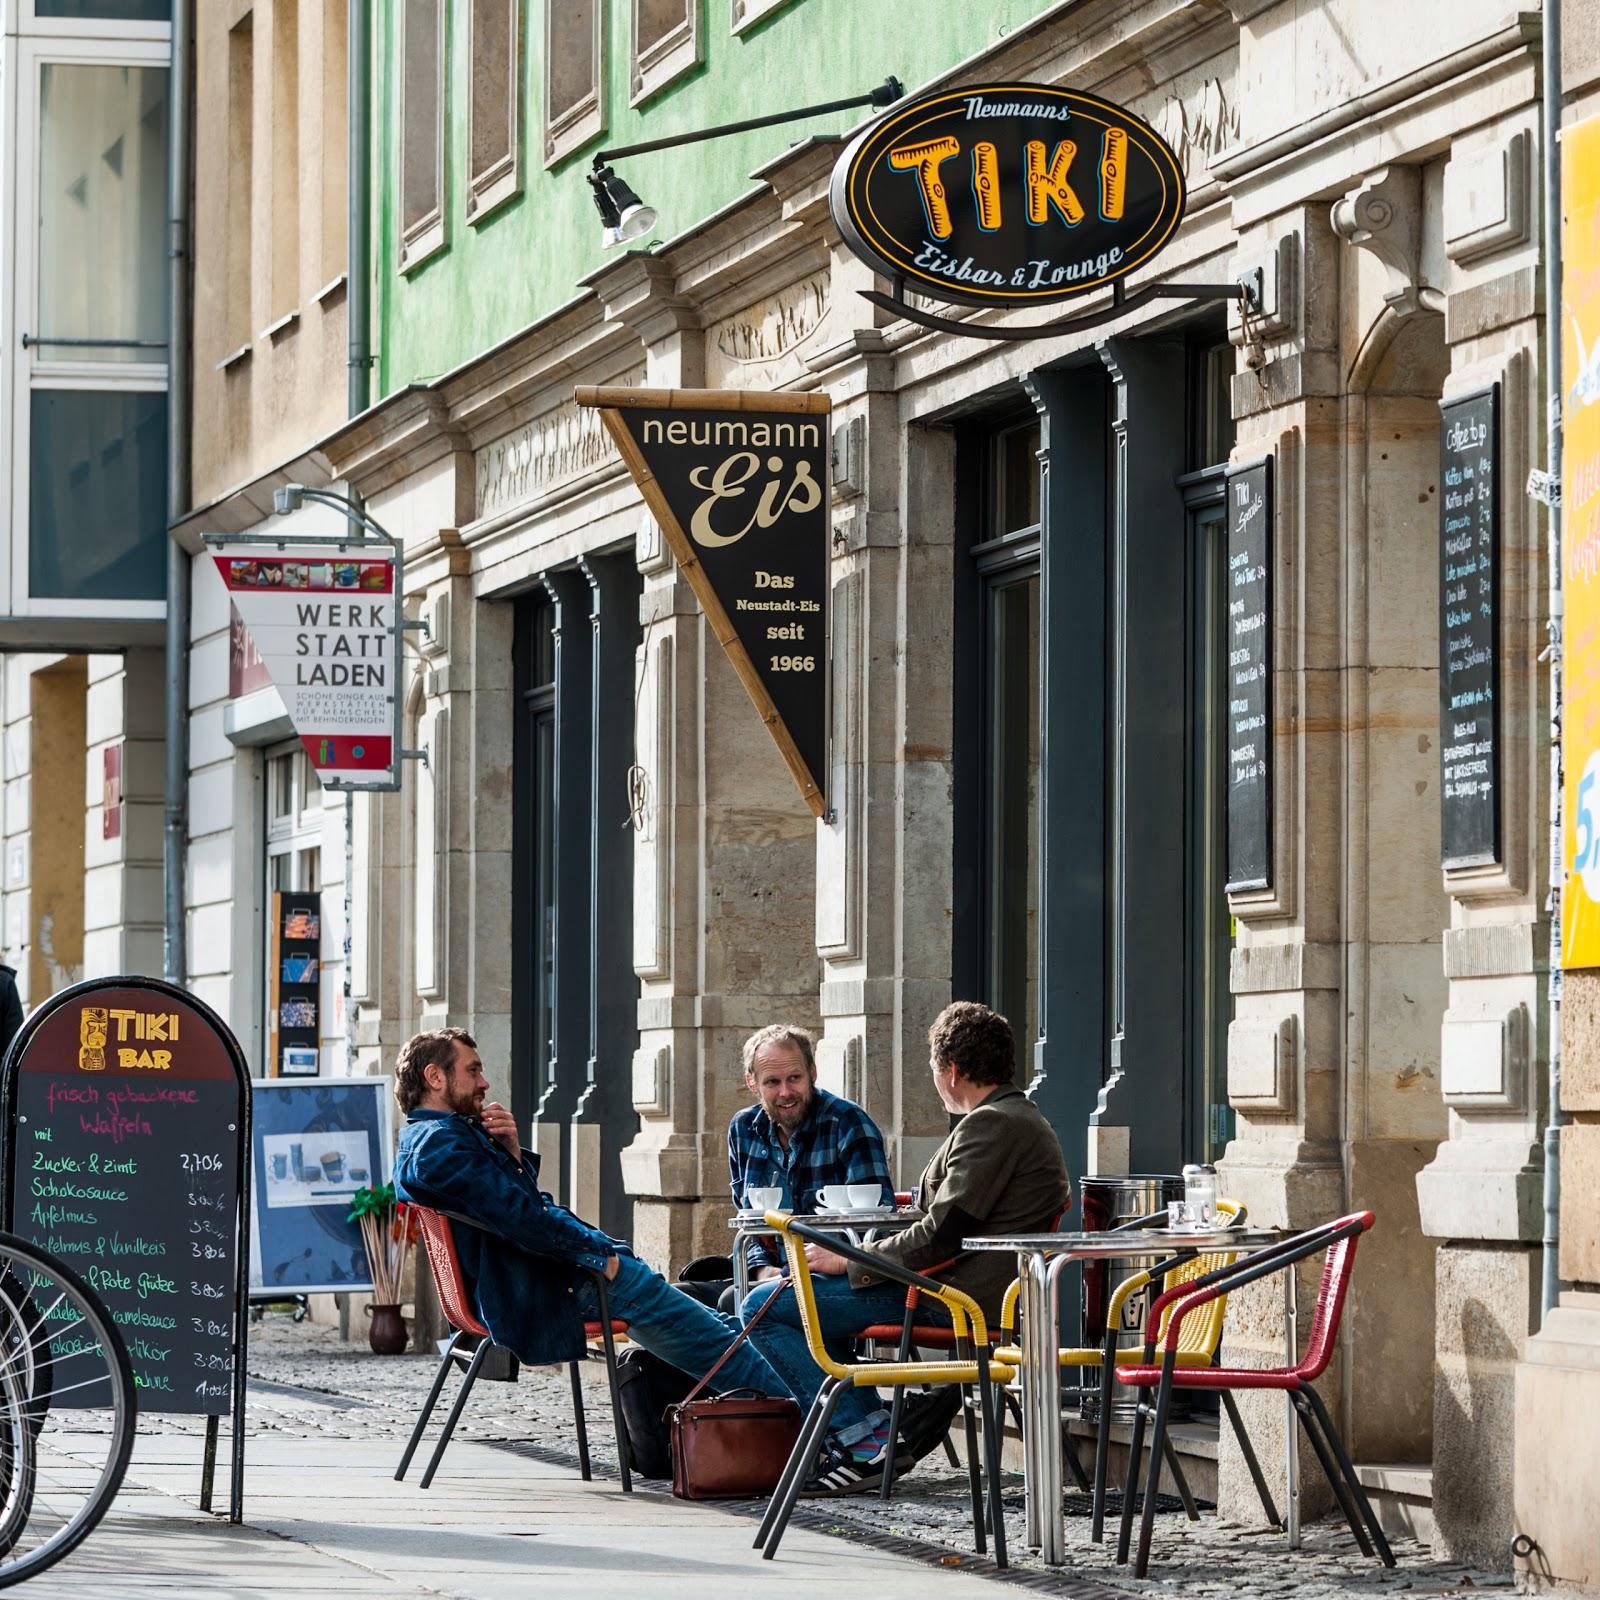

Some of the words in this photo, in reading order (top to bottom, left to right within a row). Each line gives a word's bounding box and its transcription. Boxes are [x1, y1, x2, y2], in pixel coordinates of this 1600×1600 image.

[964, 96, 1070, 121] Neumanns
[888, 126, 1128, 243] TIKI
[913, 240, 1007, 287] Eisbar
[1010, 268, 1026, 287] &
[1027, 245, 1124, 290] Lounge
[643, 419, 819, 447] neumann
[689, 452, 822, 548] Eis
[755, 571, 795, 589] Das
[297, 604, 385, 627] WERK
[736, 599, 820, 612] Neustadt-Eis
[767, 623, 805, 640] seit
[296, 633, 386, 657] STATT
[770, 655, 815, 672] 1966
[297, 664, 385, 687] LADEN
[296, 692, 333, 700] SCHÖNE
[337, 693, 364, 701] DINGE
[368, 693, 385, 701] AUS
[296, 708, 315, 716] FÜR
[313, 716, 385, 724] BEHINDERUNGEN
[109, 1008, 179, 1042] TIKI
[118, 1048, 173, 1070] BAR
[47, 1081, 99, 1114] frisch
[106, 1084, 199, 1114] gebackene
[34, 1127, 53, 1142] mit
[32, 1152, 84, 1173] Zucker
[89, 1153, 101, 1175] &
[30, 1177, 128, 1202] Schokosauce
[30, 1202, 98, 1229] Apfelmus
[100, 1269, 132, 1290] Rote
[137, 1272, 179, 1299] Grütze
